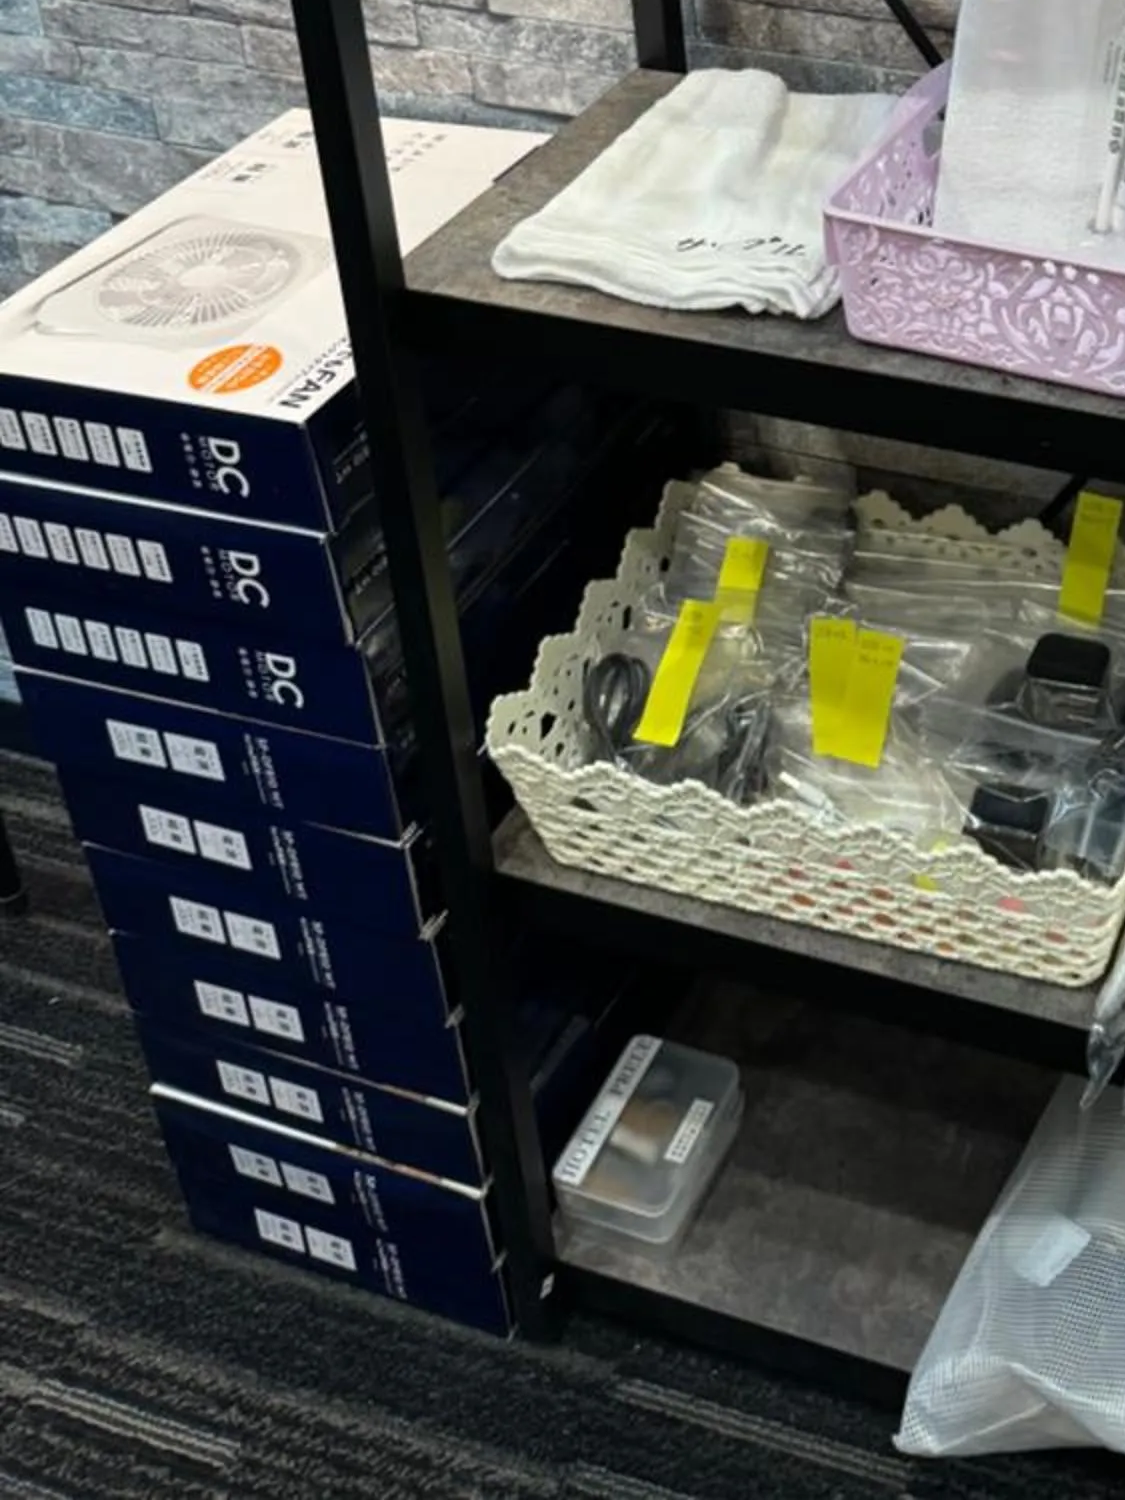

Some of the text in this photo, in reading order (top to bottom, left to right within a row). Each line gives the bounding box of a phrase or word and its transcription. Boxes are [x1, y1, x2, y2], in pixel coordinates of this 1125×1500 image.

[206, 436, 250, 499] DC
[227, 550, 271, 609] DC
[264, 652, 305, 710] DC
